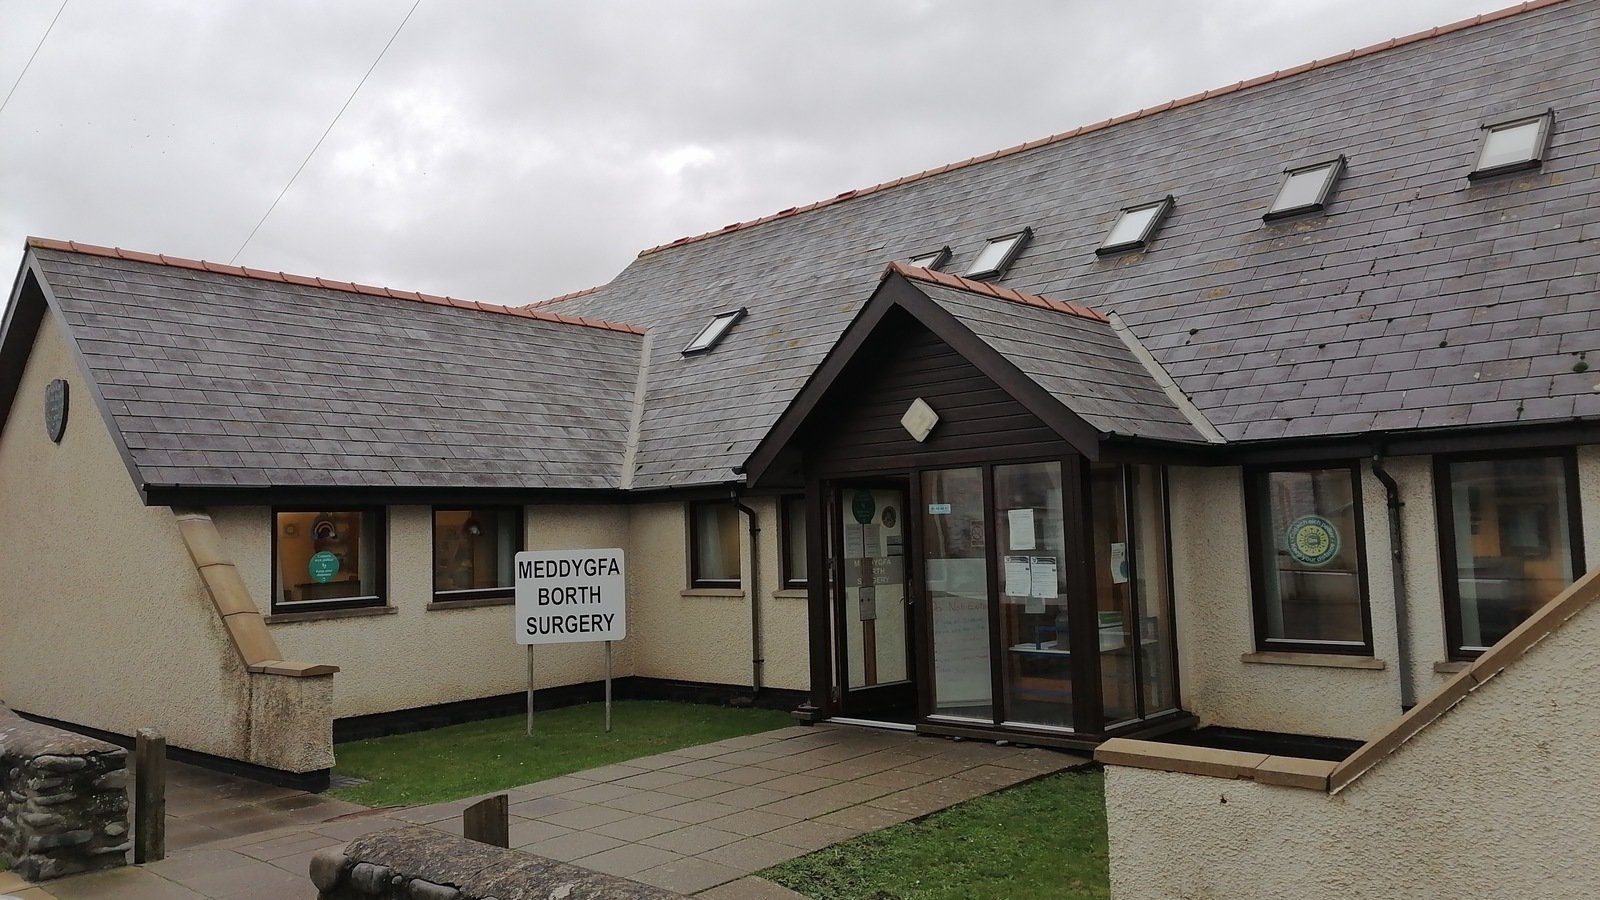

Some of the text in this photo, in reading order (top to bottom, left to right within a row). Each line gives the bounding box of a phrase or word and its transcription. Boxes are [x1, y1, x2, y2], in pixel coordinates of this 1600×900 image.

[518, 558, 620, 579] MEDDYGFA
[854, 559, 891, 567] MYGFA
[856, 576, 889, 585] SGERY
[538, 586, 601, 606] BORTH
[526, 613, 615, 635] SURGERY
